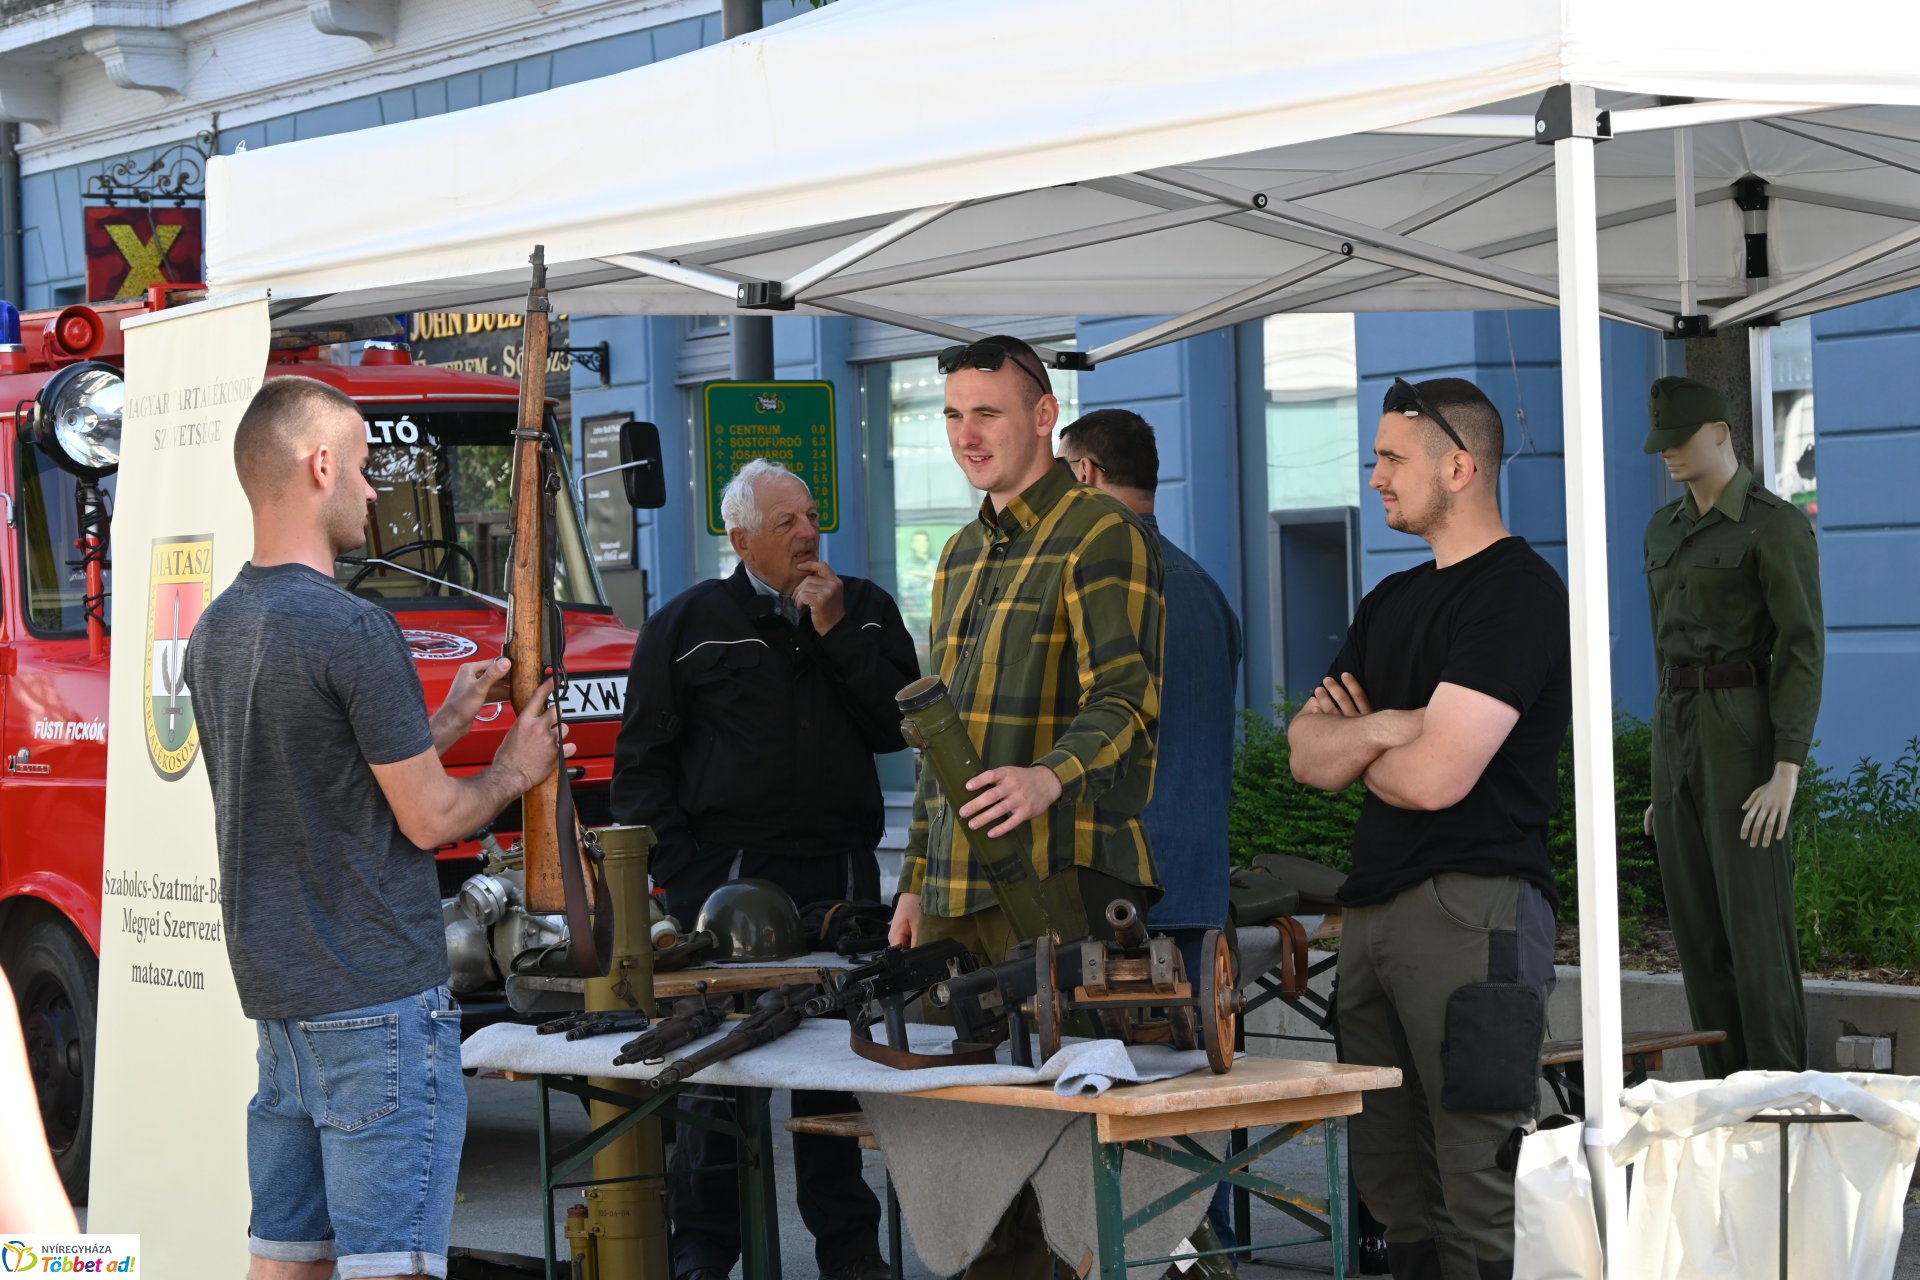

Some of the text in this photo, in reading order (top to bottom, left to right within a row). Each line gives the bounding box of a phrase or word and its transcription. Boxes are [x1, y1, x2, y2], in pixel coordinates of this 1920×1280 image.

[729, 425, 781, 435] CENTRUM
[34, 717, 106, 741] FÜSTI FICKÓK
[121, 907, 221, 943] Megyei Szervezet
[131, 962, 205, 990] matasz.com
